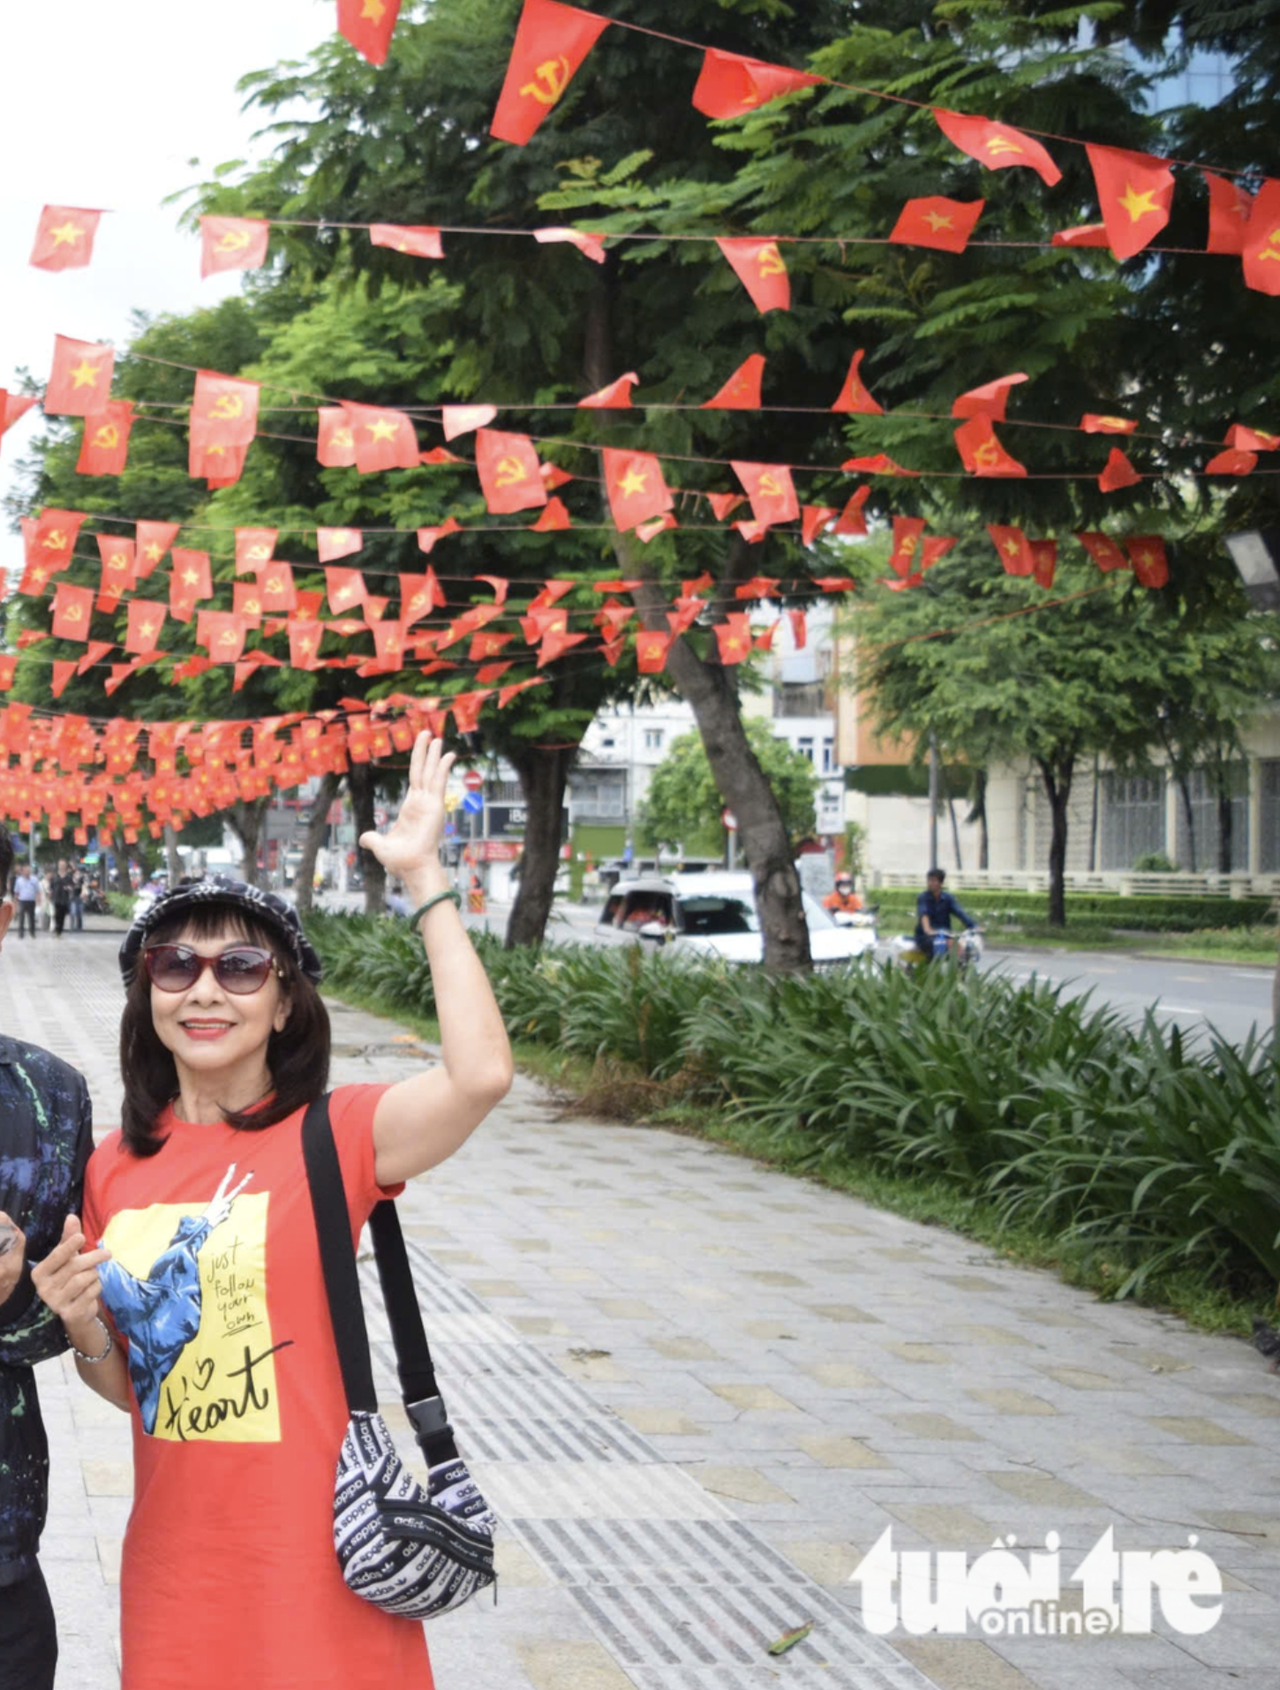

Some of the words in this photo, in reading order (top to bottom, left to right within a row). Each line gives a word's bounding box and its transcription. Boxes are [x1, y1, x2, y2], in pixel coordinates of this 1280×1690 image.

[207, 1236, 244, 1281] just
[214, 1274, 255, 1297] follow
[217, 1294, 253, 1321] your
[226, 1313, 255, 1330] own
[165, 1340, 294, 1441] Heart
[341, 1498, 374, 1528] adidas
